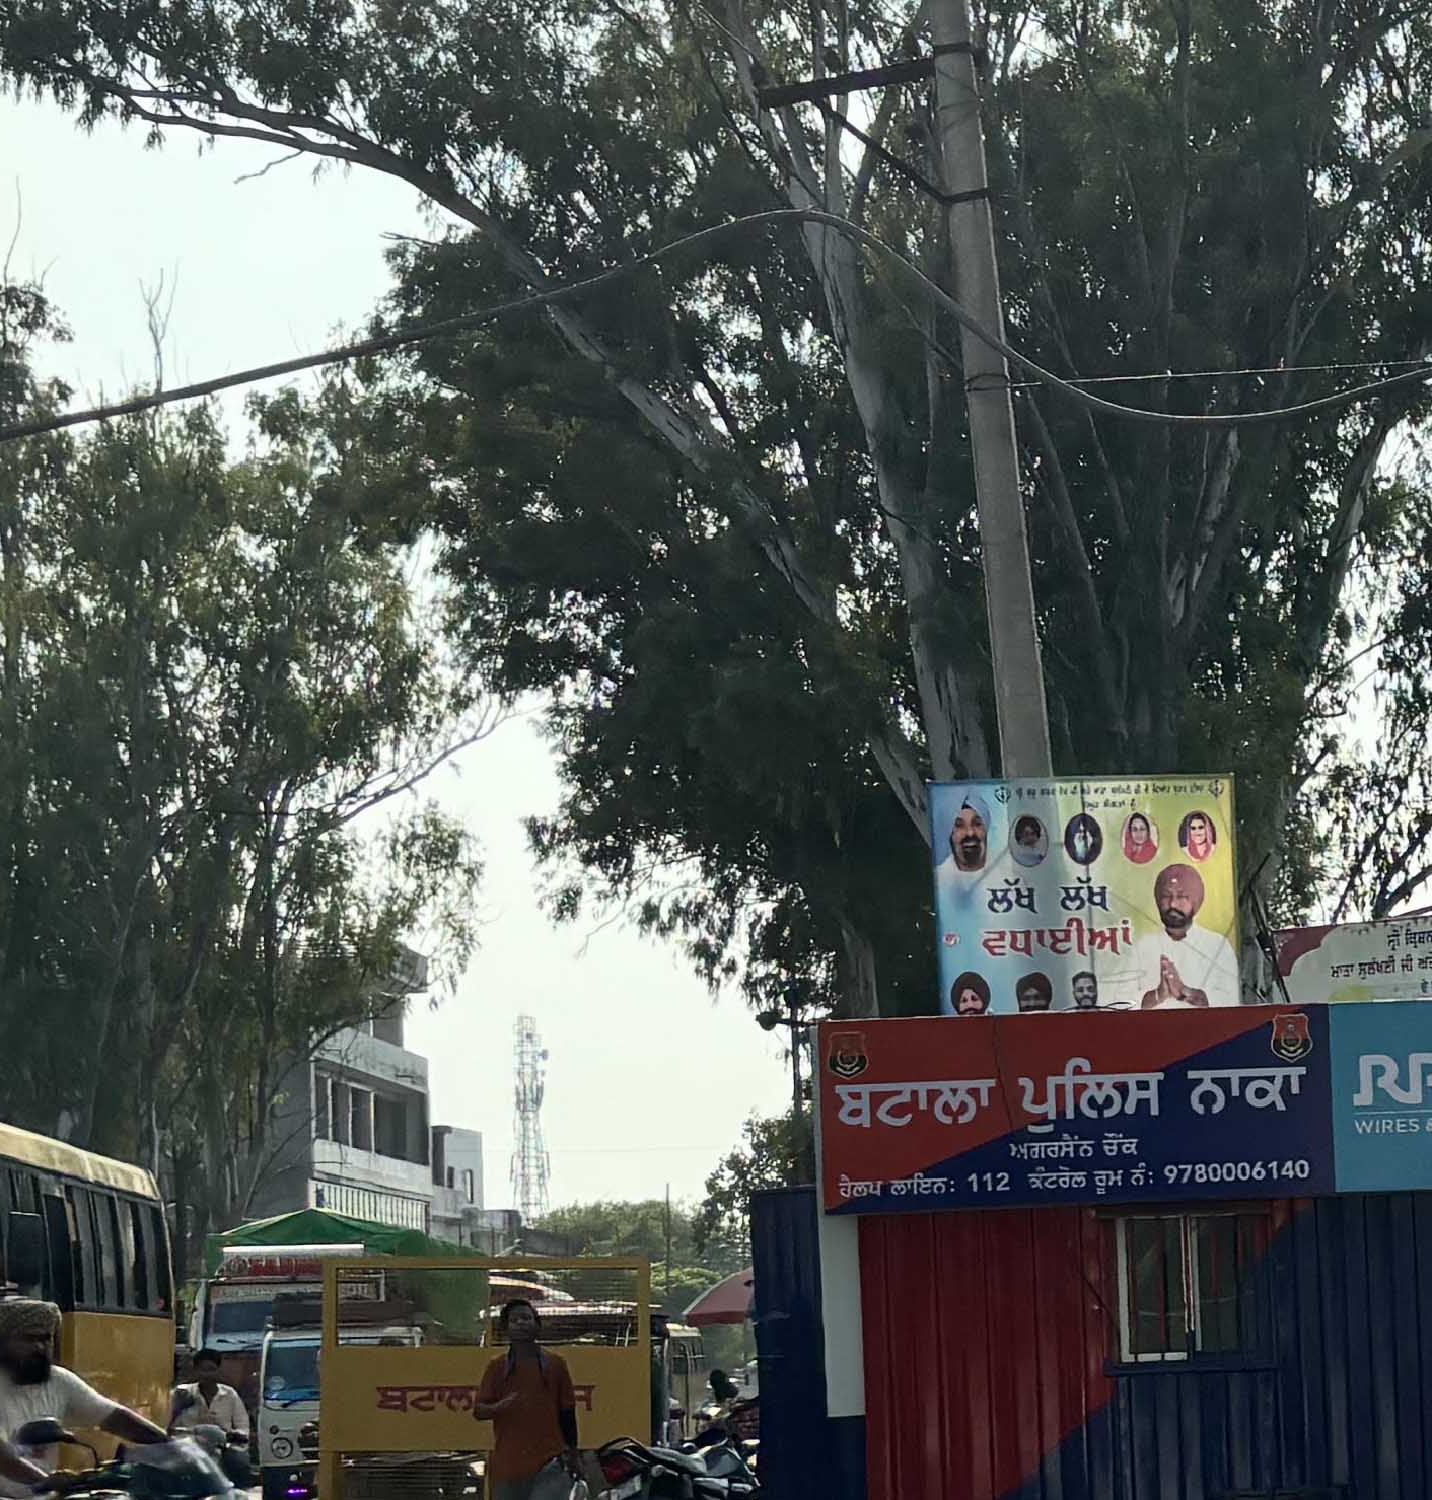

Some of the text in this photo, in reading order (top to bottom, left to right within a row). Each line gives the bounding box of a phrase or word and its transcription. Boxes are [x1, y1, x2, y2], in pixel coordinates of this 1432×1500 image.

[987, 876, 1110, 914] ਲੱਖ ਲੱਖ
[982, 918, 1133, 957] ਵਧਾਈਆਂ
[835, 1057, 1307, 1133] ਬਟਾਲਾ ਪੁਲਿਸ ਨਾਕਾ
[1354, 1118, 1420, 1135] WIRES
[839, 1174, 883, 1198] ਹੈਲਪ
[968, 1172, 1010, 1193] 112
[1093, 1170, 1123, 1195] ਰੂਮ
[1164, 1159, 1310, 1184] 9780006140
[376, 1384, 478, 1414] ਬਟਾਲ
